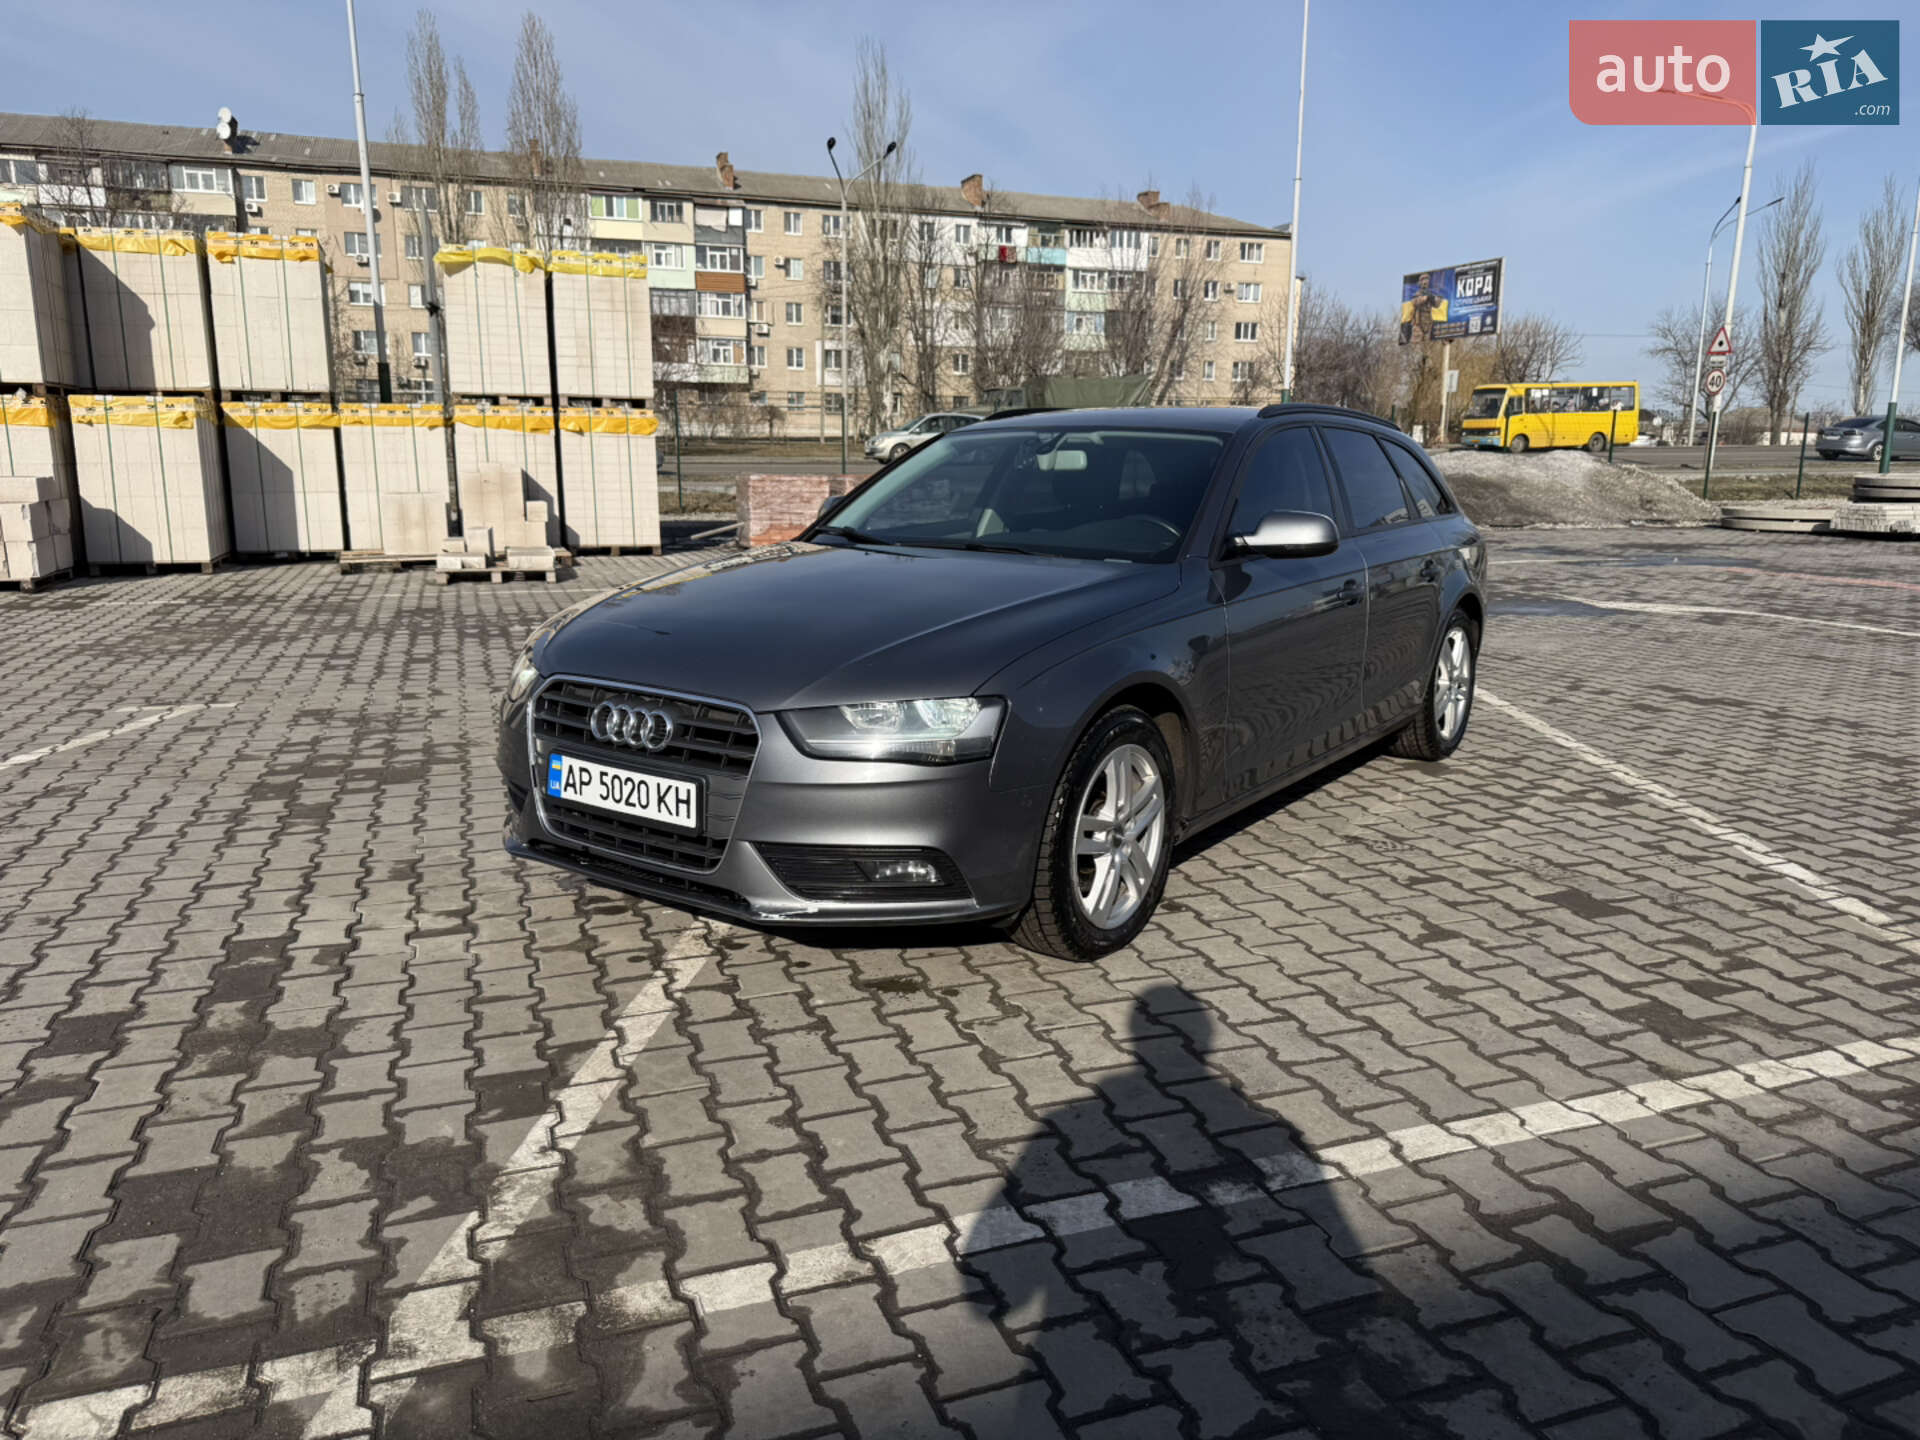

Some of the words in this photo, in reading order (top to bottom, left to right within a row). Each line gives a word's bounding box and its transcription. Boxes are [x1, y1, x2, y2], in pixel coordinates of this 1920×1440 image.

[1709, 375, 1722, 388] 40
[563, 764, 592, 796] AP
[599, 771, 650, 810] 5020
[656, 782, 691, 819] KH
